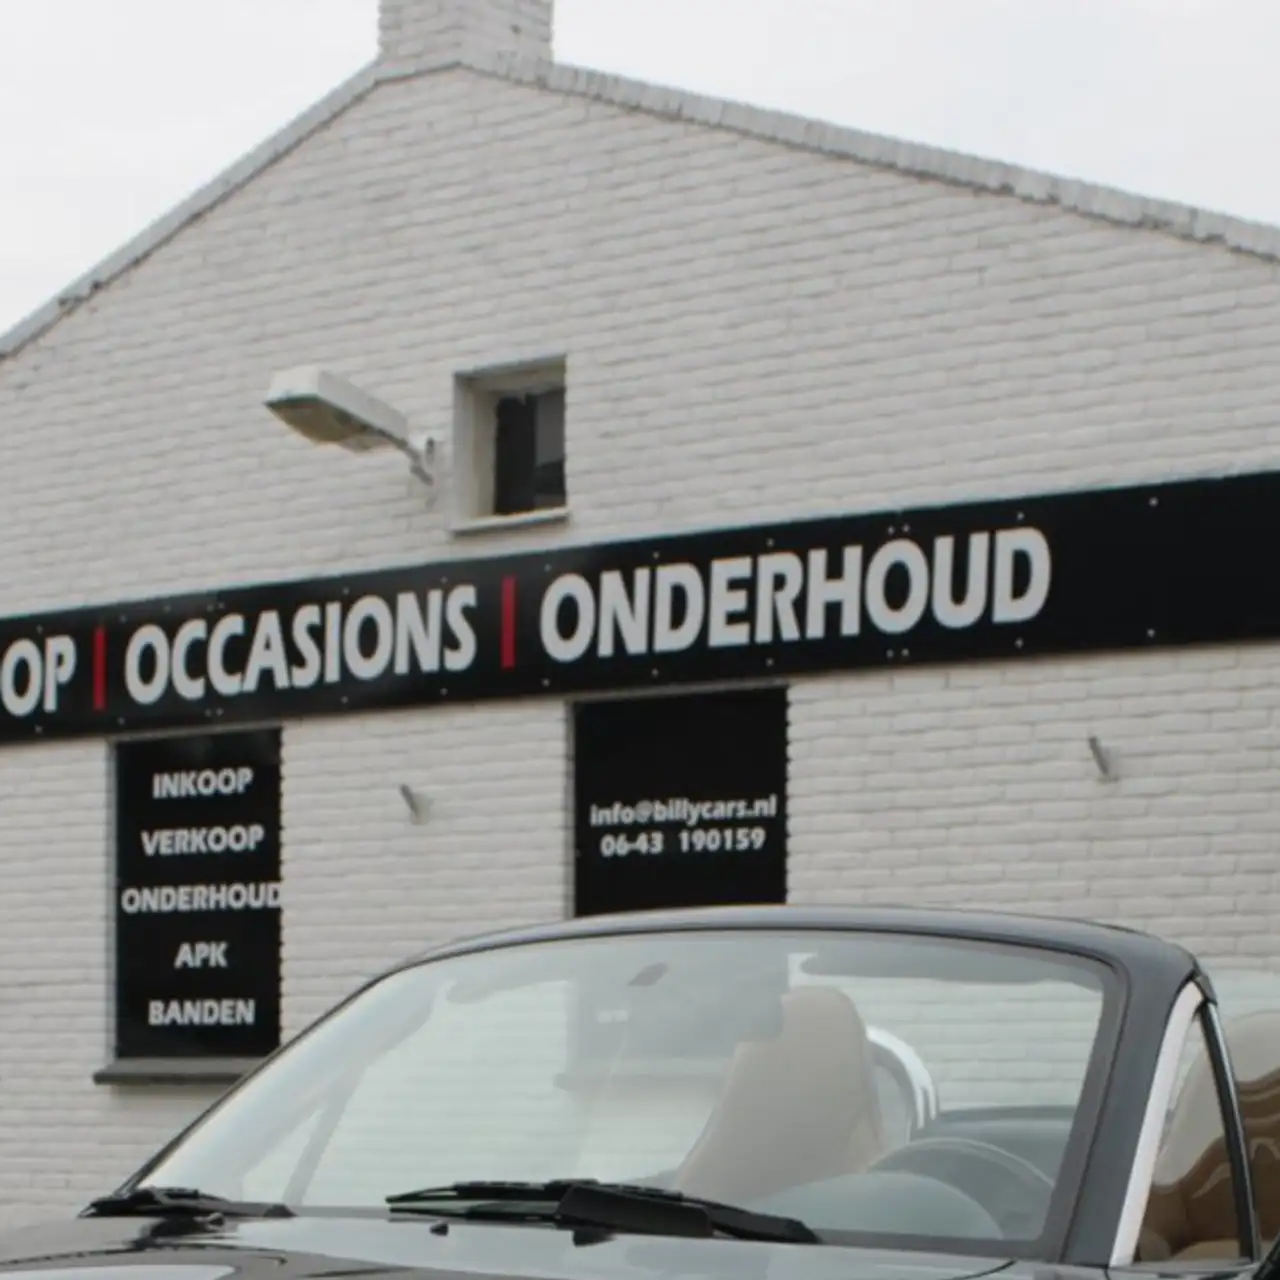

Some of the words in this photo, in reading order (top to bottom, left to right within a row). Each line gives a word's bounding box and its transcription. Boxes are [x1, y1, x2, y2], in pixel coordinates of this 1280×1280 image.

[125, 583, 477, 704] OCCASIONS
[540, 526, 1052, 662] ONDERHOUD
[152, 767, 254, 799] INKOOP
[590, 793, 778, 826] info@billycars.nl
[140, 824, 265, 856] VERKOOP
[600, 831, 664, 857] 06-43
[679, 828, 766, 853] 190159
[121, 883, 280, 913] ONDERHOUD
[174, 942, 228, 969] APK
[148, 999, 256, 1025] BANDEN
